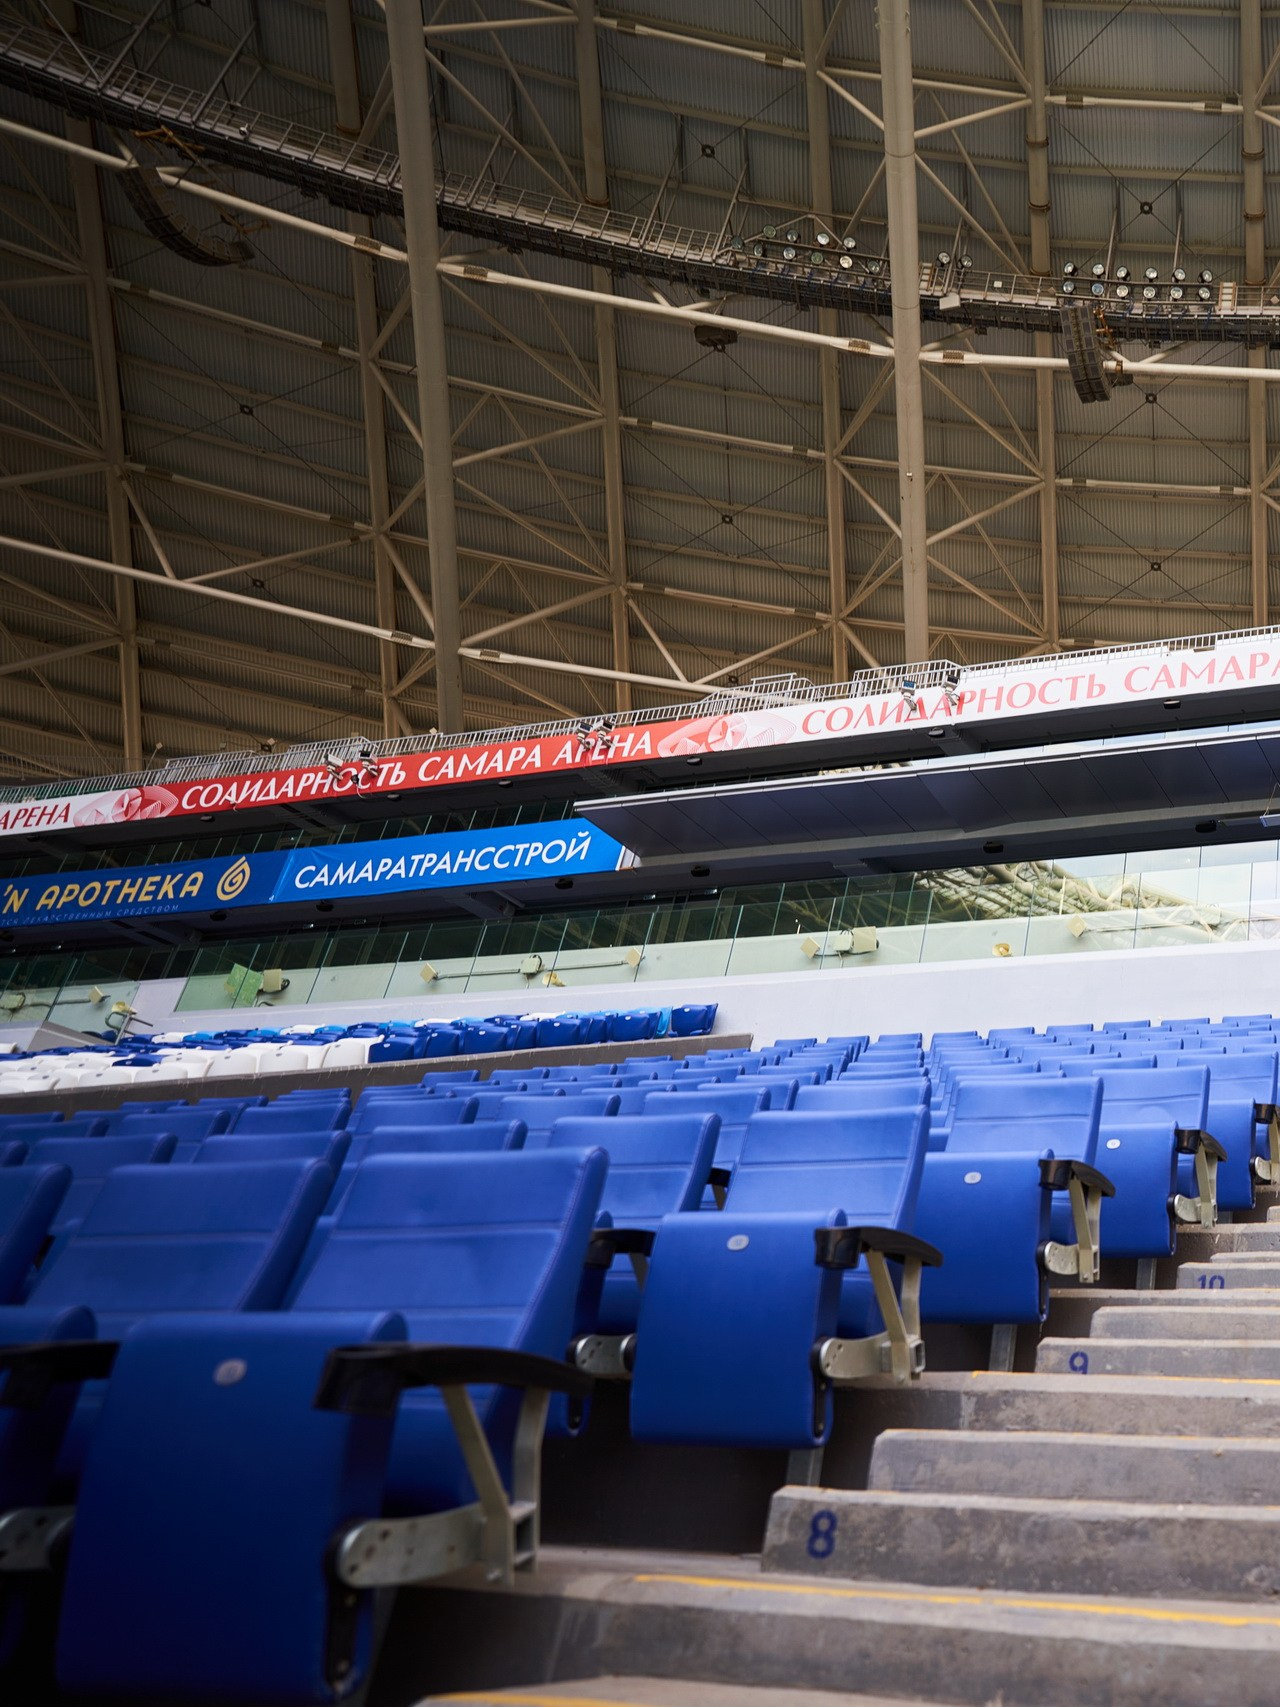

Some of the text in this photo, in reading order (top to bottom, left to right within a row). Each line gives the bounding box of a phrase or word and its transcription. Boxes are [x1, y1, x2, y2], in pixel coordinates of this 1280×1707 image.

[801, 673, 1106, 735] СОЛИДАРНОСТЬ
[418, 744, 541, 782] САМАРА
[552, 730, 652, 766] АРЕНА
[294, 831, 593, 889] САМАРАТРАНССТРОЙ
[1069, 1351, 1089, 1375] 9
[807, 1509, 837, 1559] 8
